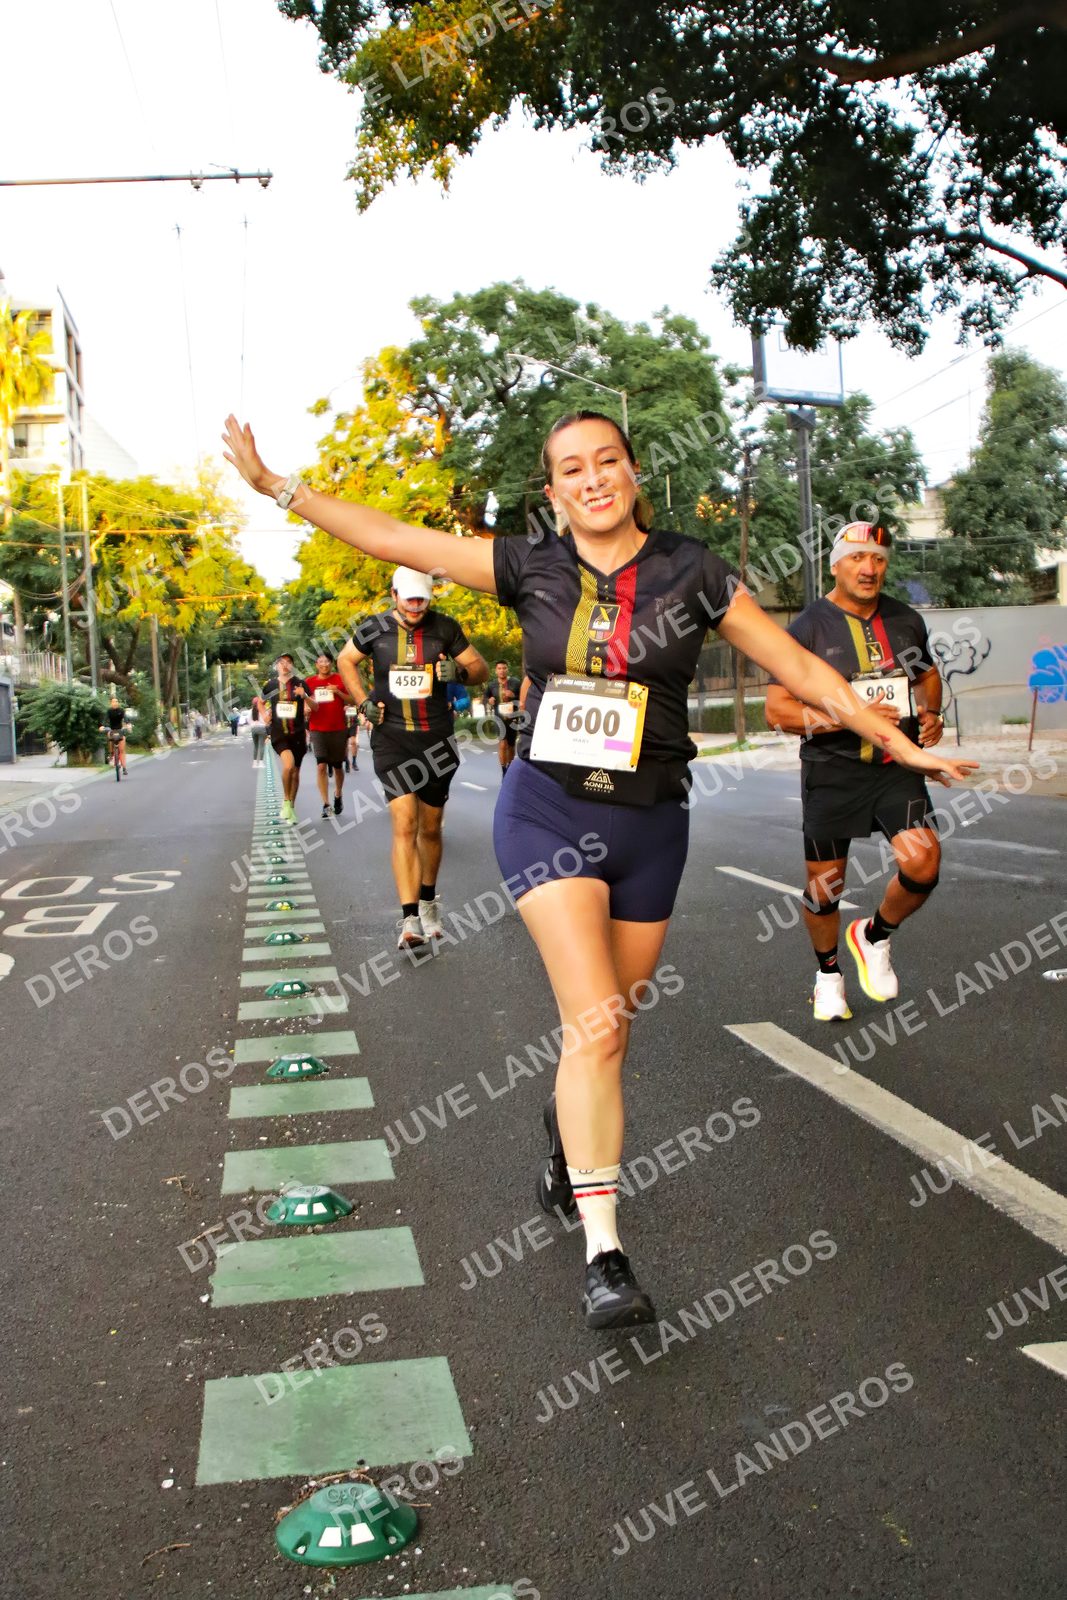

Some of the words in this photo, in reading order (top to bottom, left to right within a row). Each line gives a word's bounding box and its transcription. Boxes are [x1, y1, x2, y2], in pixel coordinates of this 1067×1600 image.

[395, 675, 424, 687] 4587
[866, 684, 895, 701] 908
[551, 703, 621, 737] 1600
